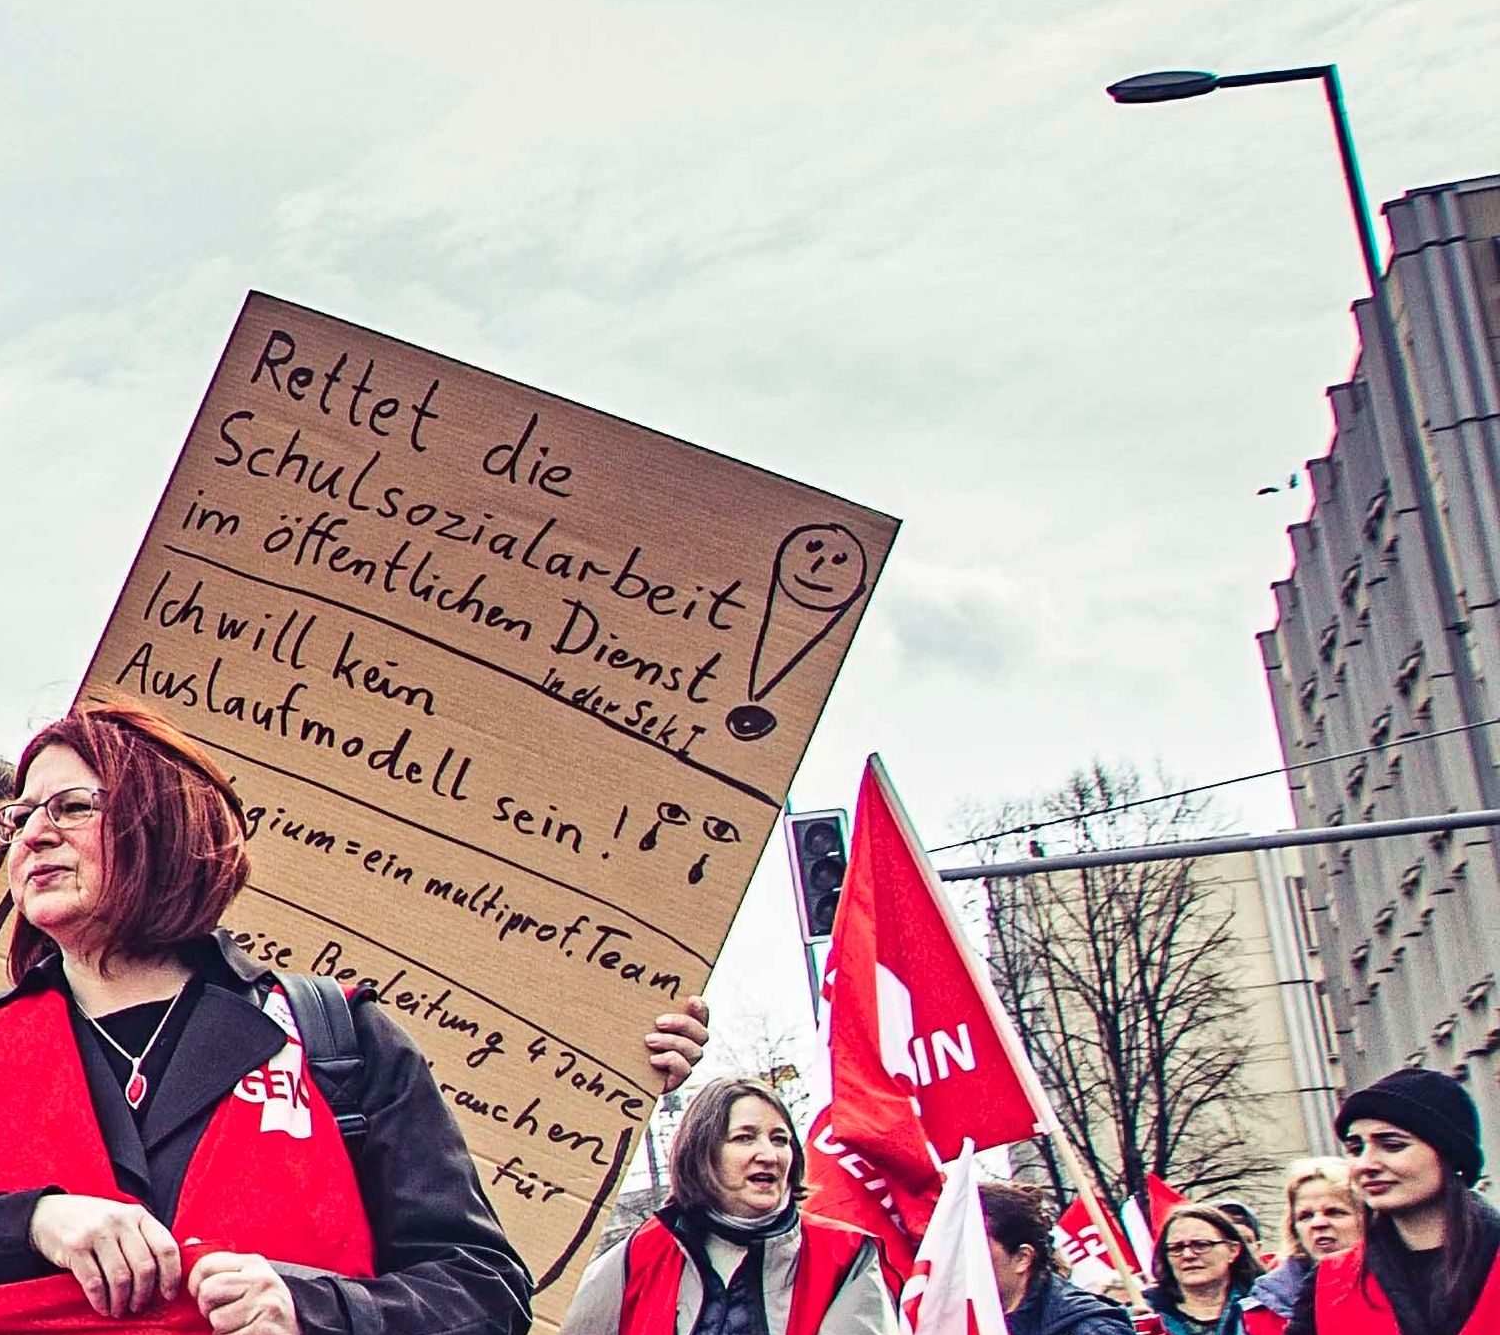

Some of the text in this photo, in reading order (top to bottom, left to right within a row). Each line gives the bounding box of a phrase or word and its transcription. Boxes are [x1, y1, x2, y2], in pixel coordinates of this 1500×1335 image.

[250, 329, 573, 498] Rettet die
[214, 410, 747, 630] Schulsozialarbeit
[143, 570, 436, 716] Ich will kein
[181, 489, 241, 536] im
[263, 511, 533, 642] öffentlichen
[550, 598, 722, 703] Dienst
[115, 641, 472, 801] Auslaufmodell
[493, 796, 583, 853] sein
[586, 925, 681, 1000] Team
[439, 1081, 610, 1166] rauchen
[527, 1035, 548, 1063] 4
[555, 1050, 645, 1122] Jahre
[491, 1156, 566, 1202] für
